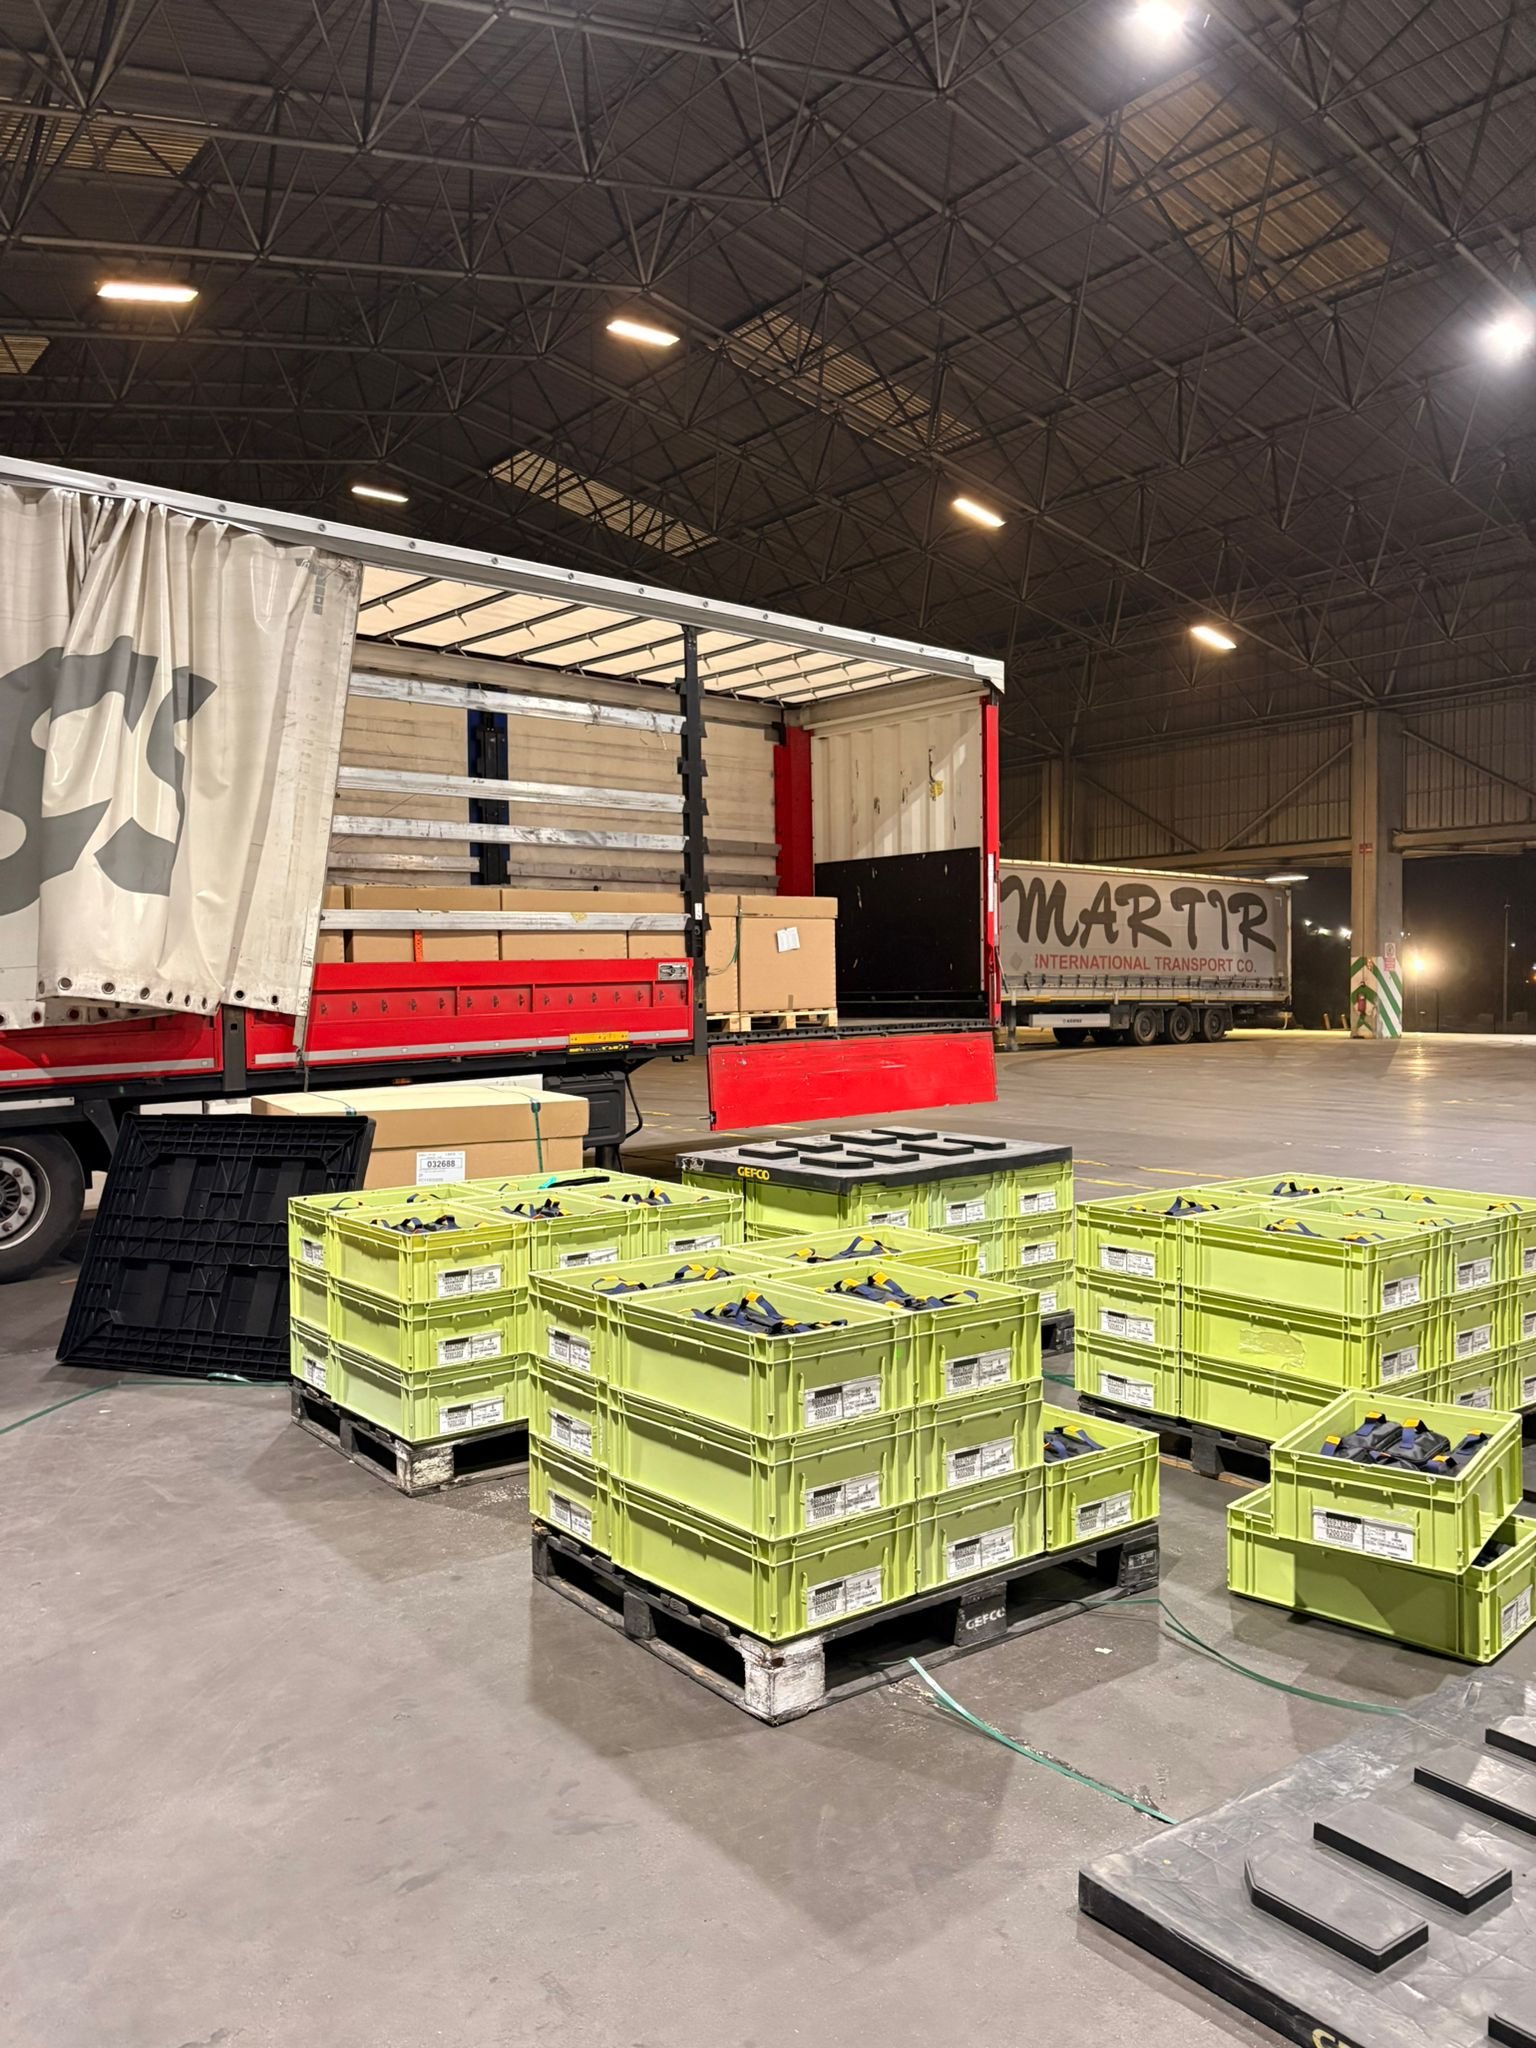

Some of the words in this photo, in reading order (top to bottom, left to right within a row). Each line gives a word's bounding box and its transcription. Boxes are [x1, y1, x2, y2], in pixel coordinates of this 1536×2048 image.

[1001, 875, 1276, 953] MARTIR
[1035, 953, 1150, 970] INTERNATIONAL
[1154, 956, 1233, 972] TRANSPORT
[1237, 959, 1257, 973] CO.
[427, 1160, 456, 1168] 032688
[737, 1166, 770, 1181] GEFCO
[965, 1606, 1006, 1630] GEFCO
